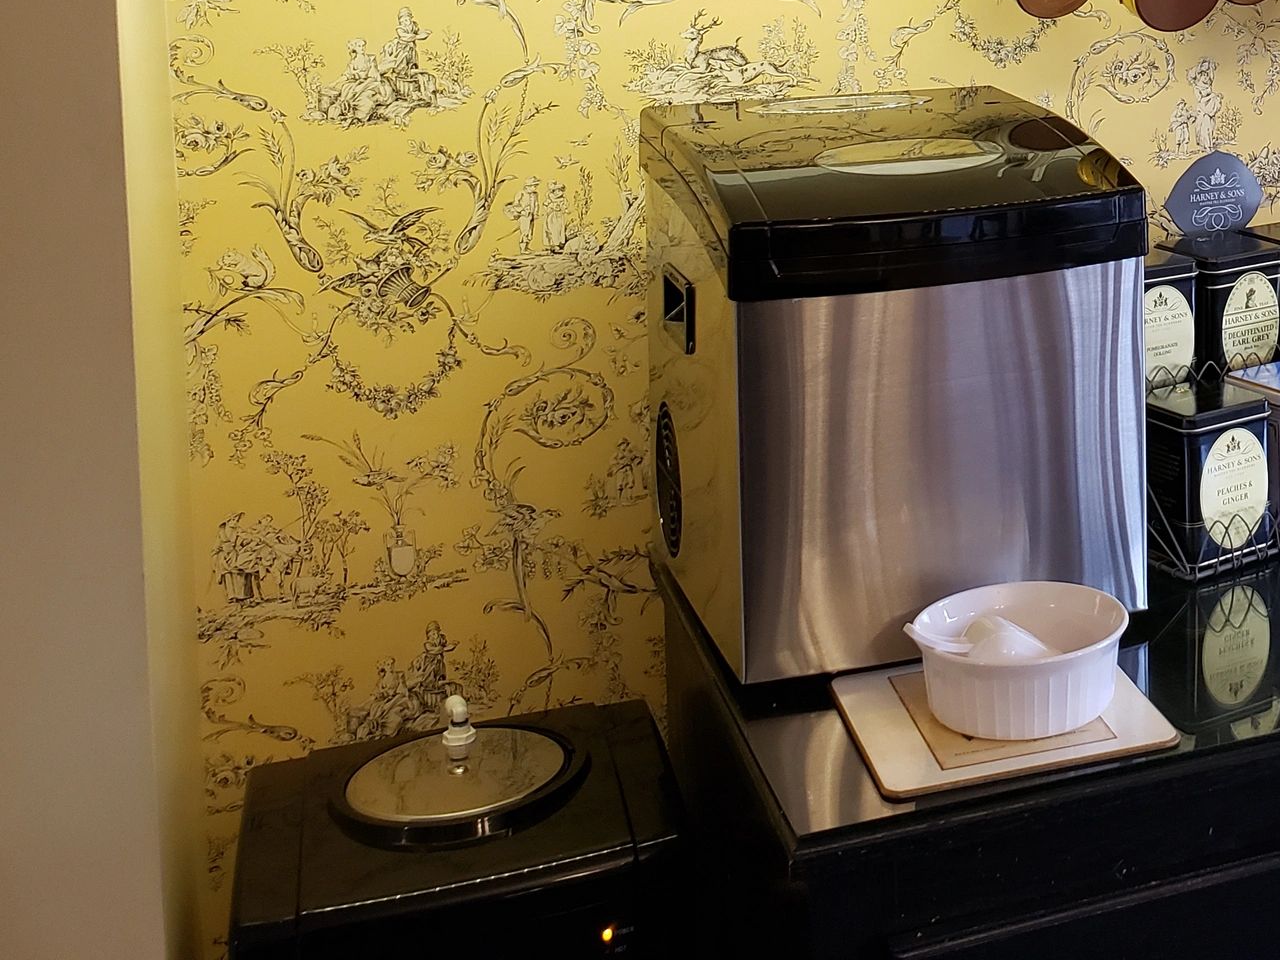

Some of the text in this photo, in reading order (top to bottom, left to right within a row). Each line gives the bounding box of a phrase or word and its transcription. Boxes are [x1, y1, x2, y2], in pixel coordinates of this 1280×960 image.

[1190, 189, 1245, 202] HARNEY & SONS
[1224, 308, 1278, 326] HARNEY & SONS
[1228, 323, 1274, 340] DECAFFEINATED
[1232, 332, 1271, 347] EARL GREY
[1207, 461, 1236, 475] HARNEY
[1244, 454, 1262, 463] SONS
[1217, 479, 1253, 497] PEACHES &
[1222, 492, 1249, 505] GINGER
